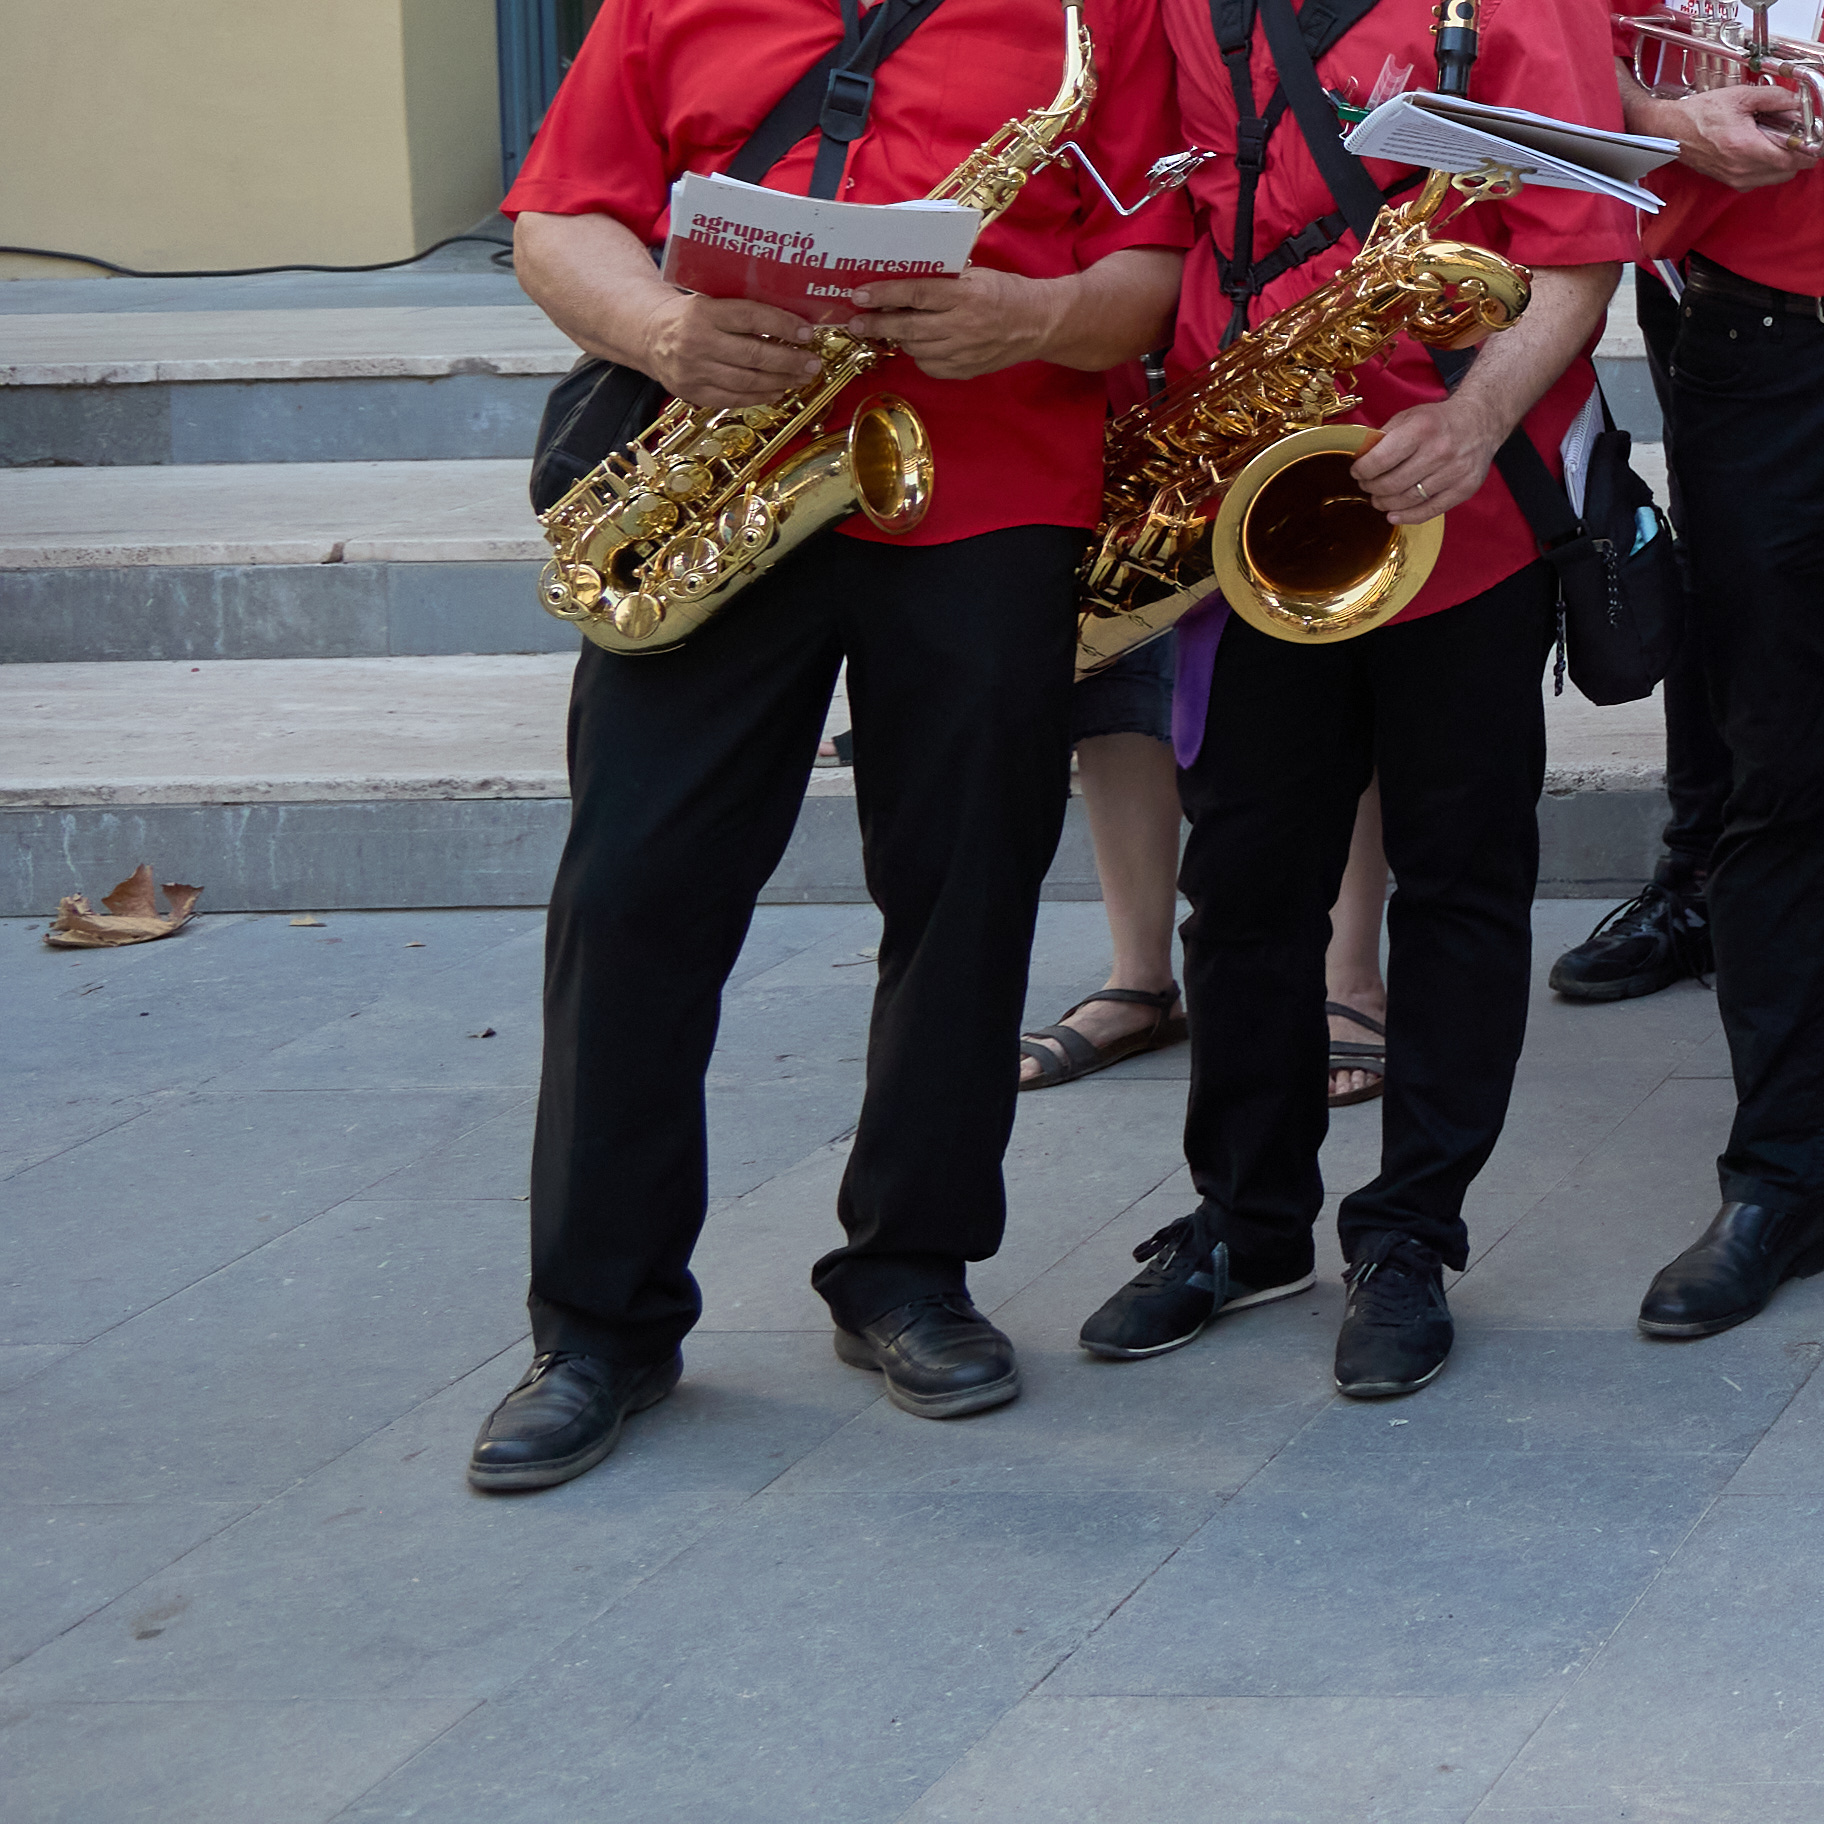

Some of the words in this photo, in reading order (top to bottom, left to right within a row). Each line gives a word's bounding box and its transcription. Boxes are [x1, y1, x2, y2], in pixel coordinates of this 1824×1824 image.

[689, 227, 784, 263] musical
[791, 249, 829, 268] del
[835, 256, 946, 273] maresme
[691, 213, 815, 250] agrupació
[806, 282, 853, 298] laba
